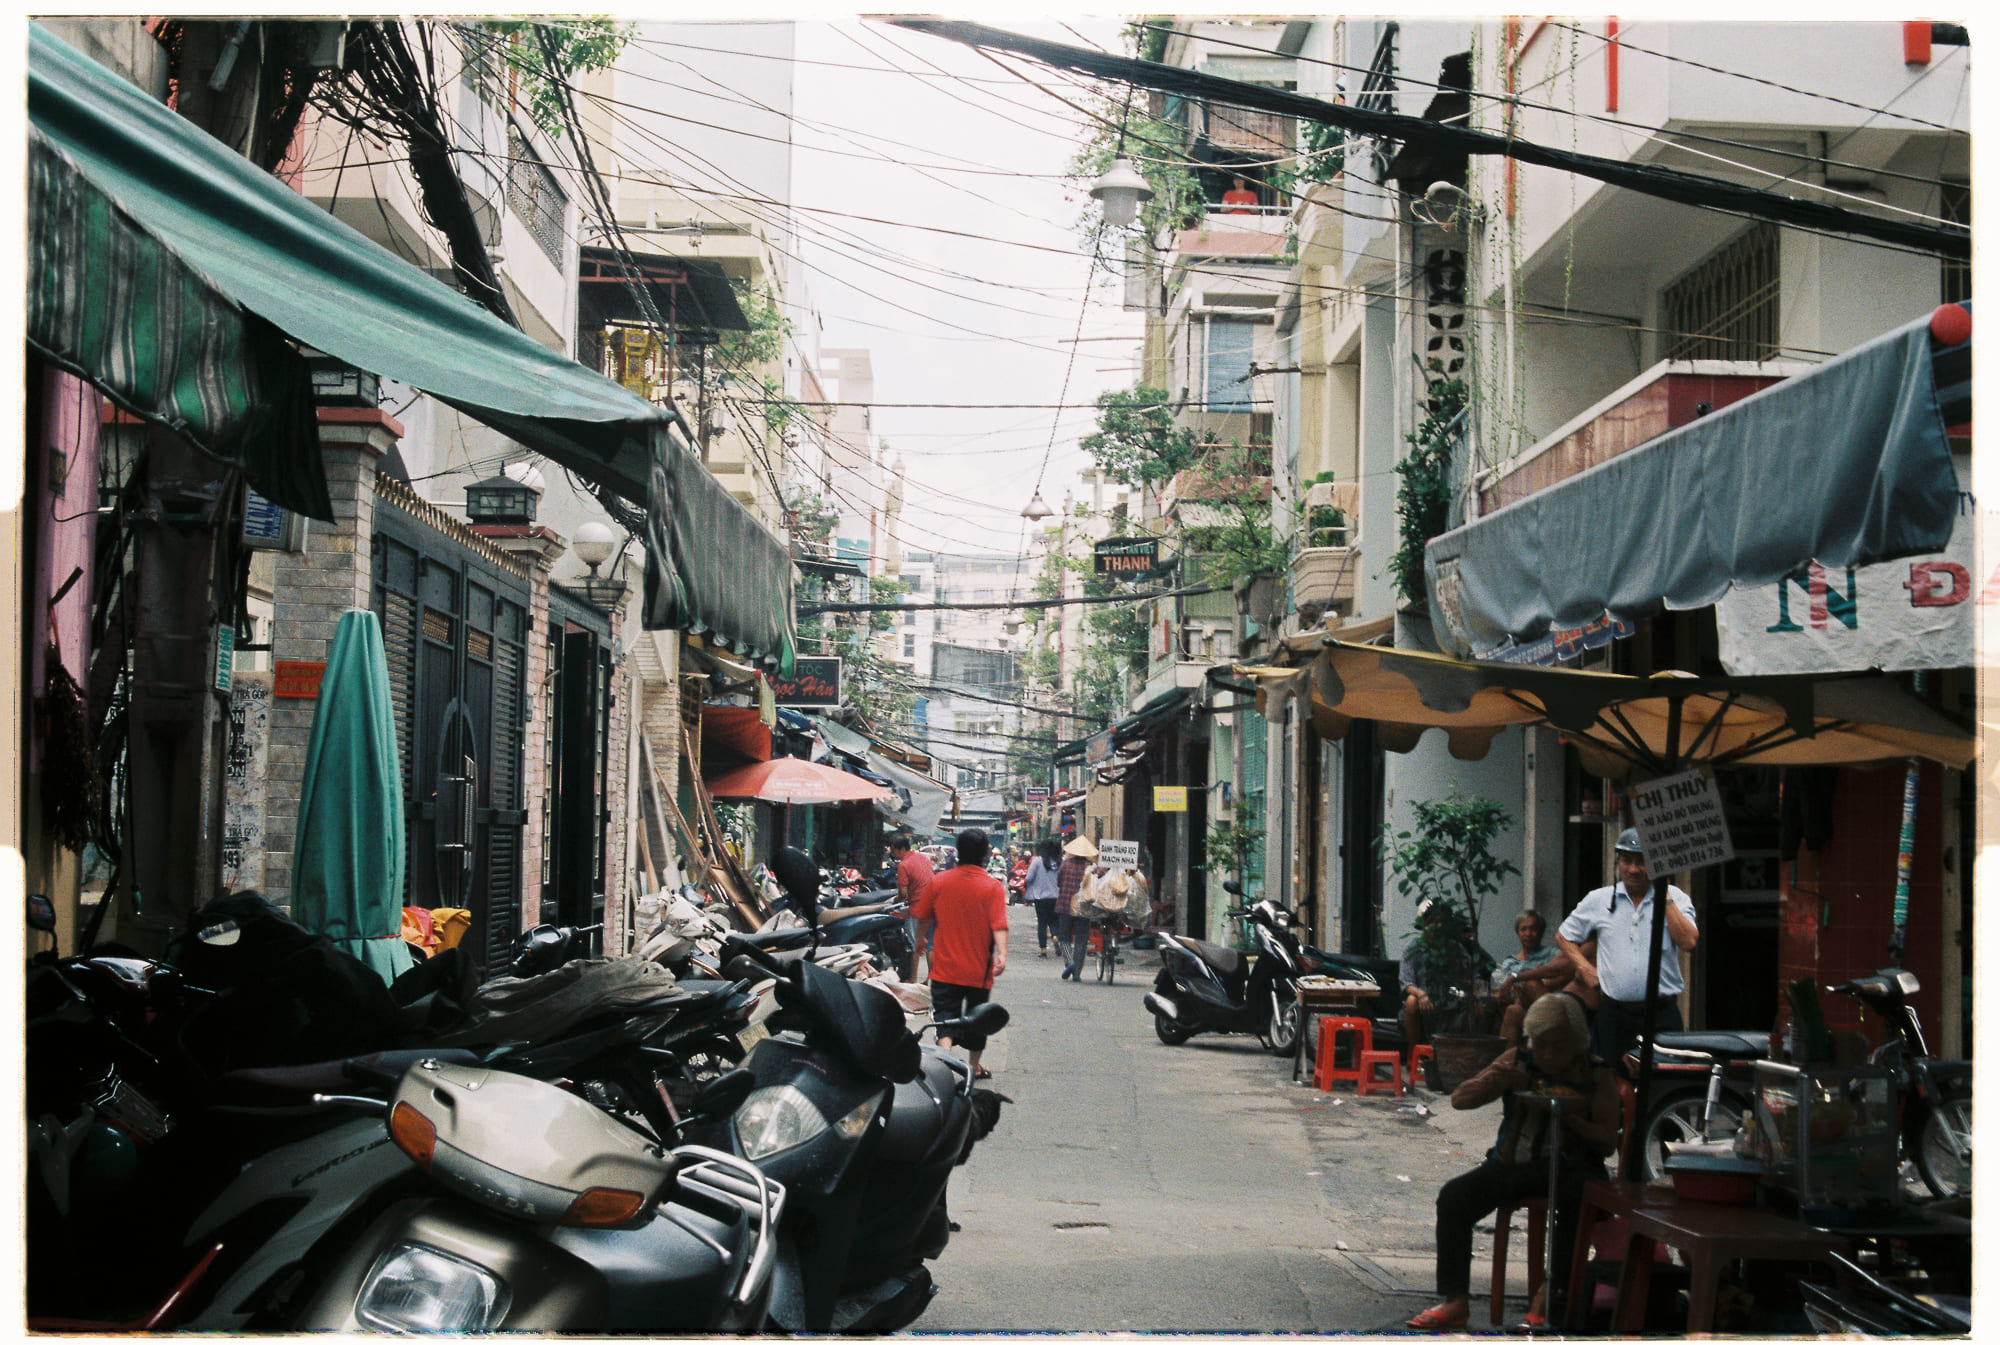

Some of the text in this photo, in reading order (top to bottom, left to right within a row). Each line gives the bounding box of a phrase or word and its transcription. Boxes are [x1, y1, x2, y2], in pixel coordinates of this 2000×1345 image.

[1103, 556, 1150, 571] THANH
[800, 676, 834, 696] Hân
[1636, 790, 1664, 810] CHỊ
